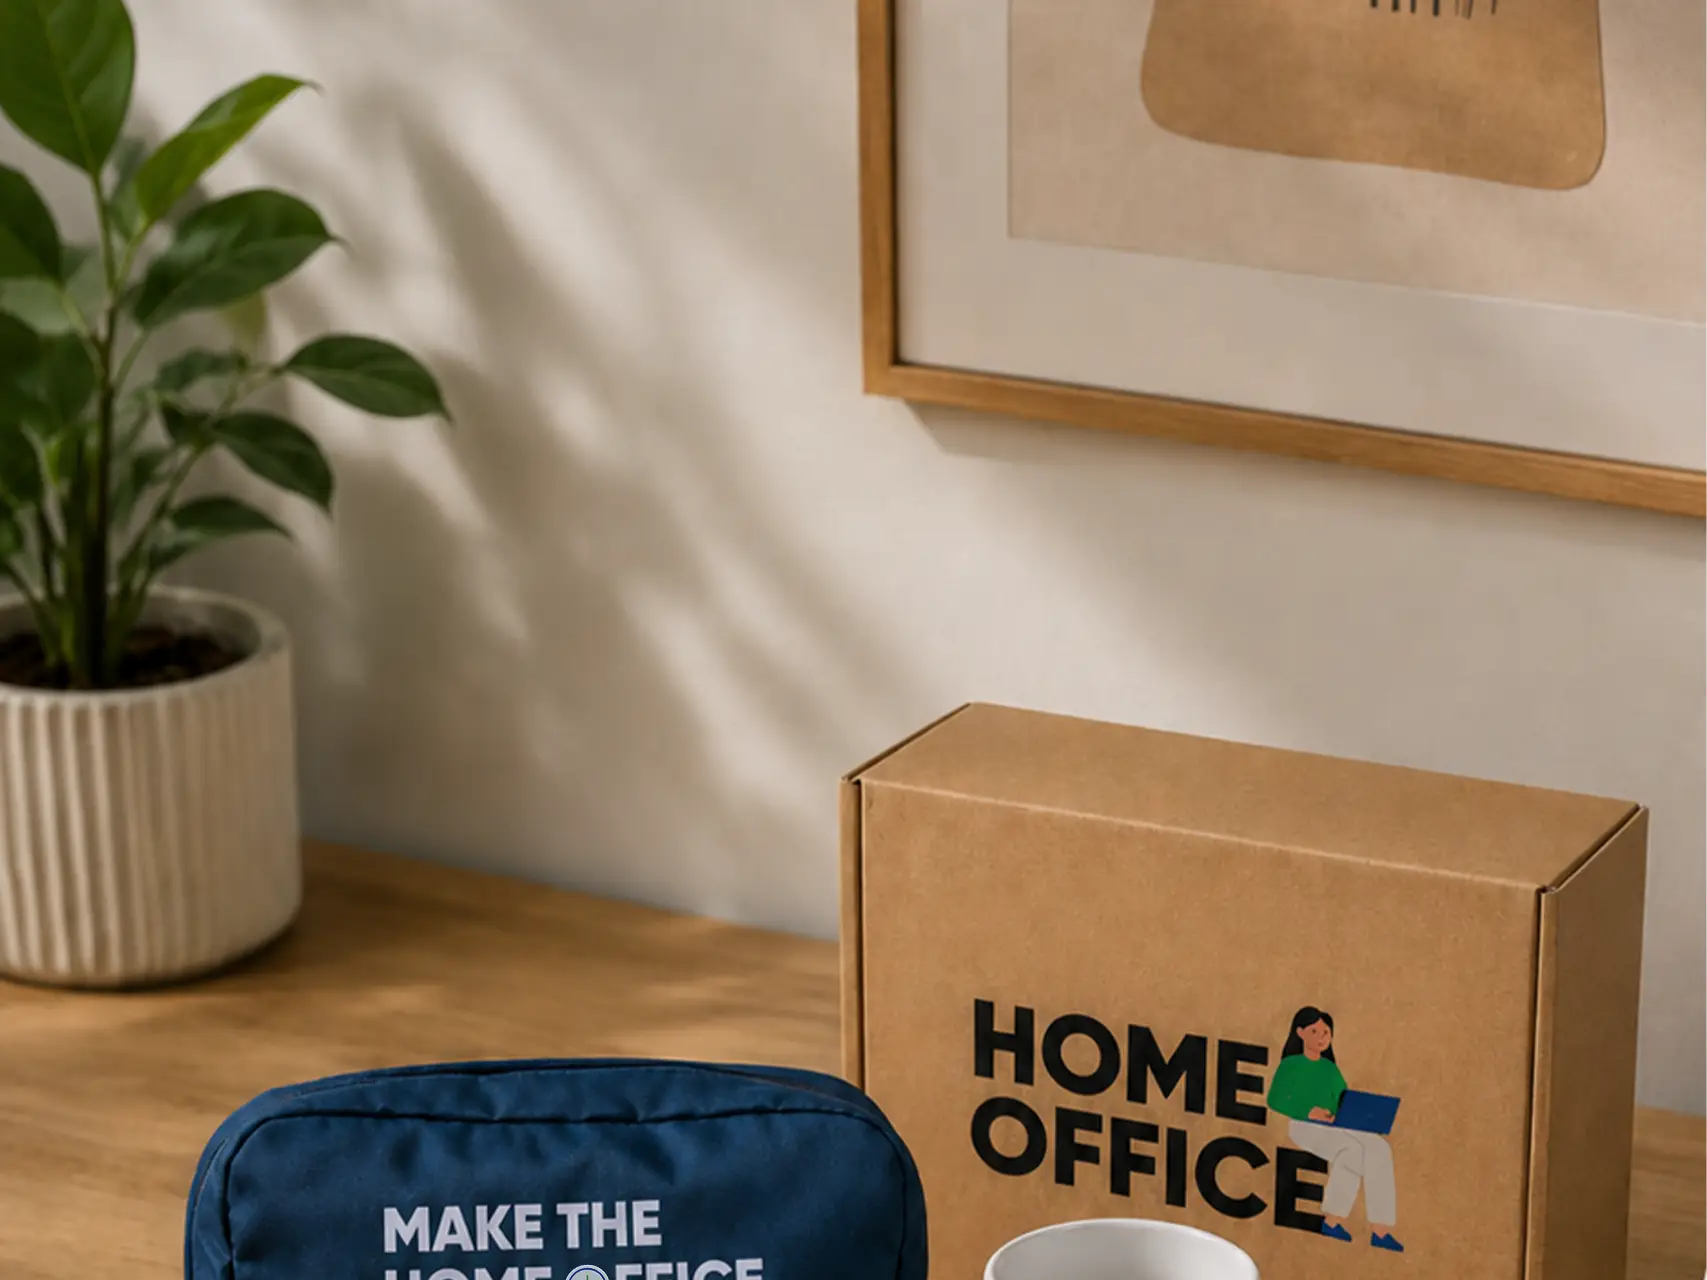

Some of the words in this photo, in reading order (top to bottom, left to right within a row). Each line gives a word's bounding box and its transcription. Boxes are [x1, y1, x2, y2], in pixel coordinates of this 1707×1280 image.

[973, 998, 1269, 1126] HOME
[383, 1204, 544, 1253] MAKE
[556, 1199, 662, 1248] THE
[970, 1096, 1329, 1234] OFFICE
